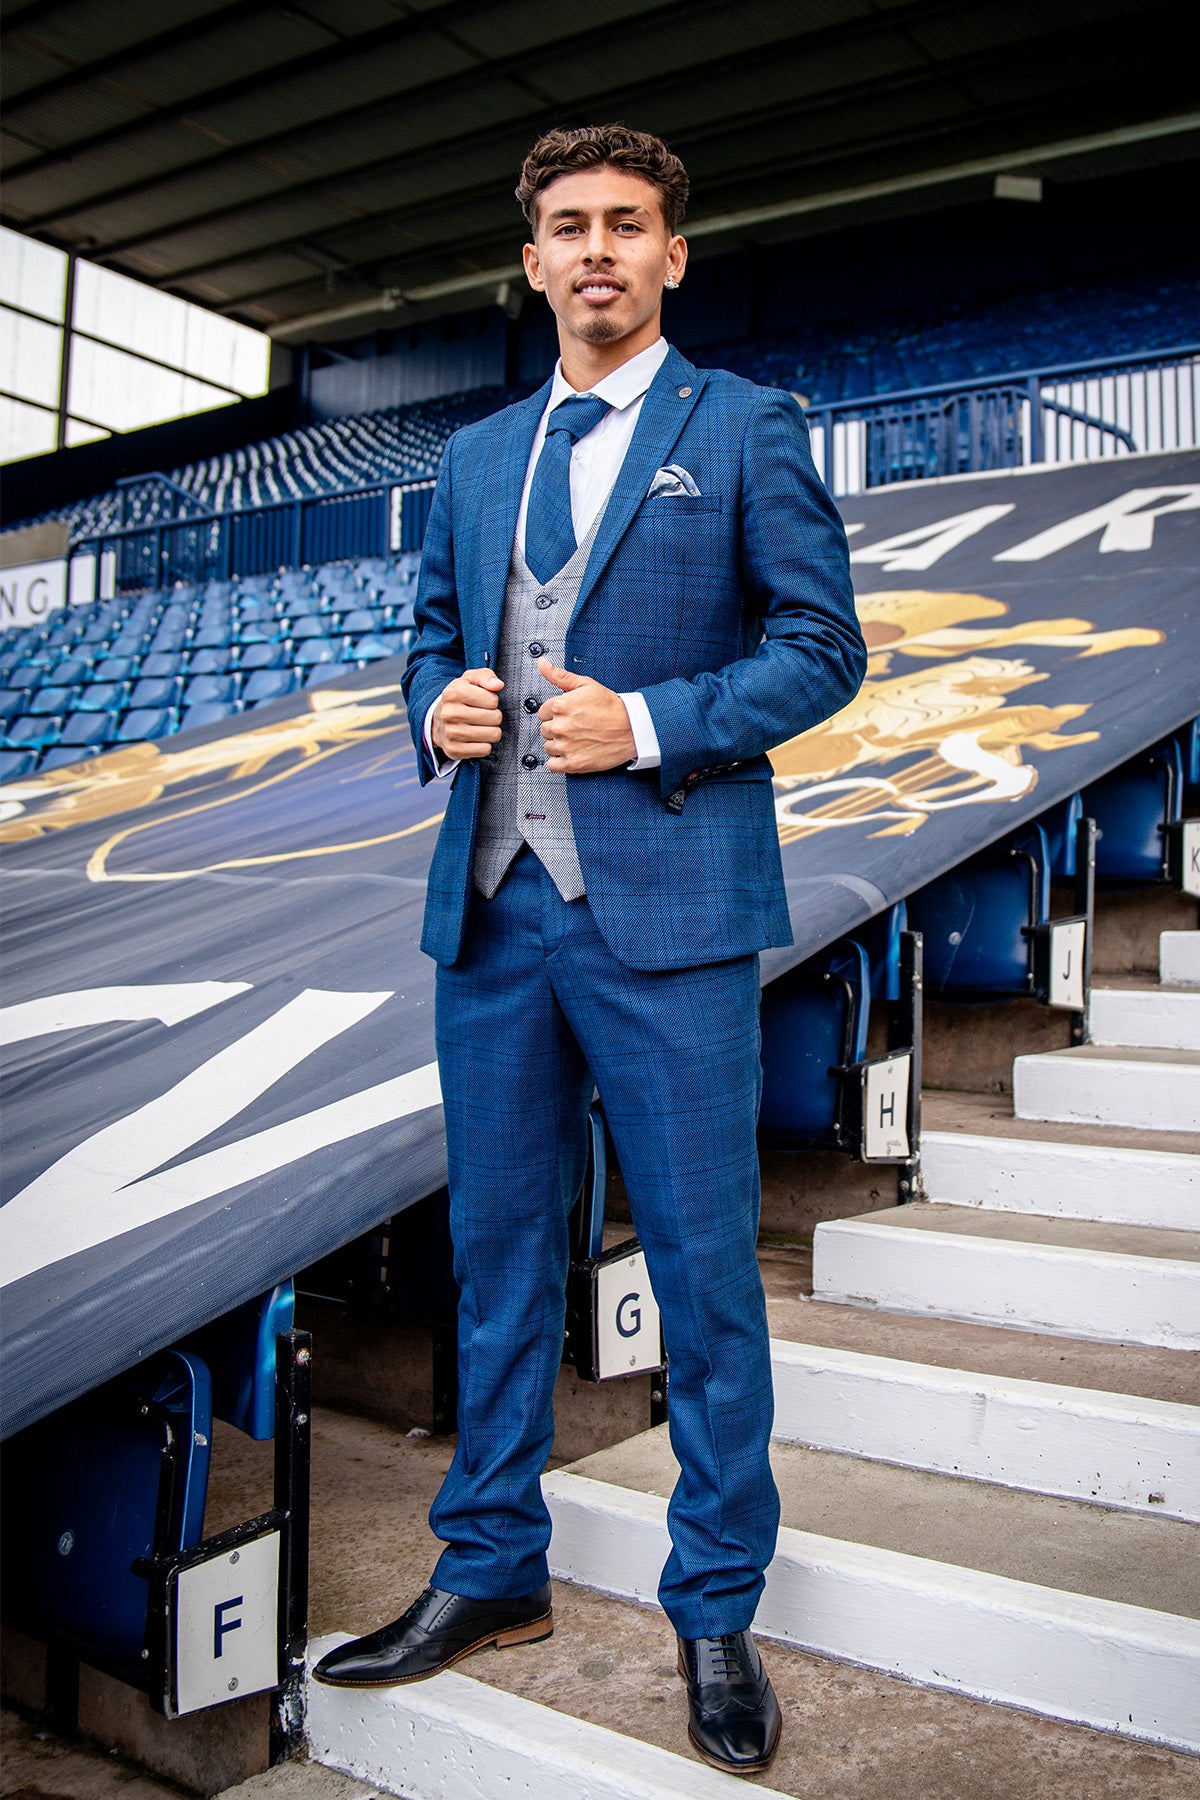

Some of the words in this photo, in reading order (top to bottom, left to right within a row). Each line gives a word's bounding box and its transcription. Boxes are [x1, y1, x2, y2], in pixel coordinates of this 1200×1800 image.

[844, 484, 1200, 573] AR
[1191, 846, 1200, 873] K
[1063, 950, 1071, 980] J
[880, 1092, 895, 1129] H
[615, 1292, 641, 1338] G
[213, 1595, 243, 1659] F
